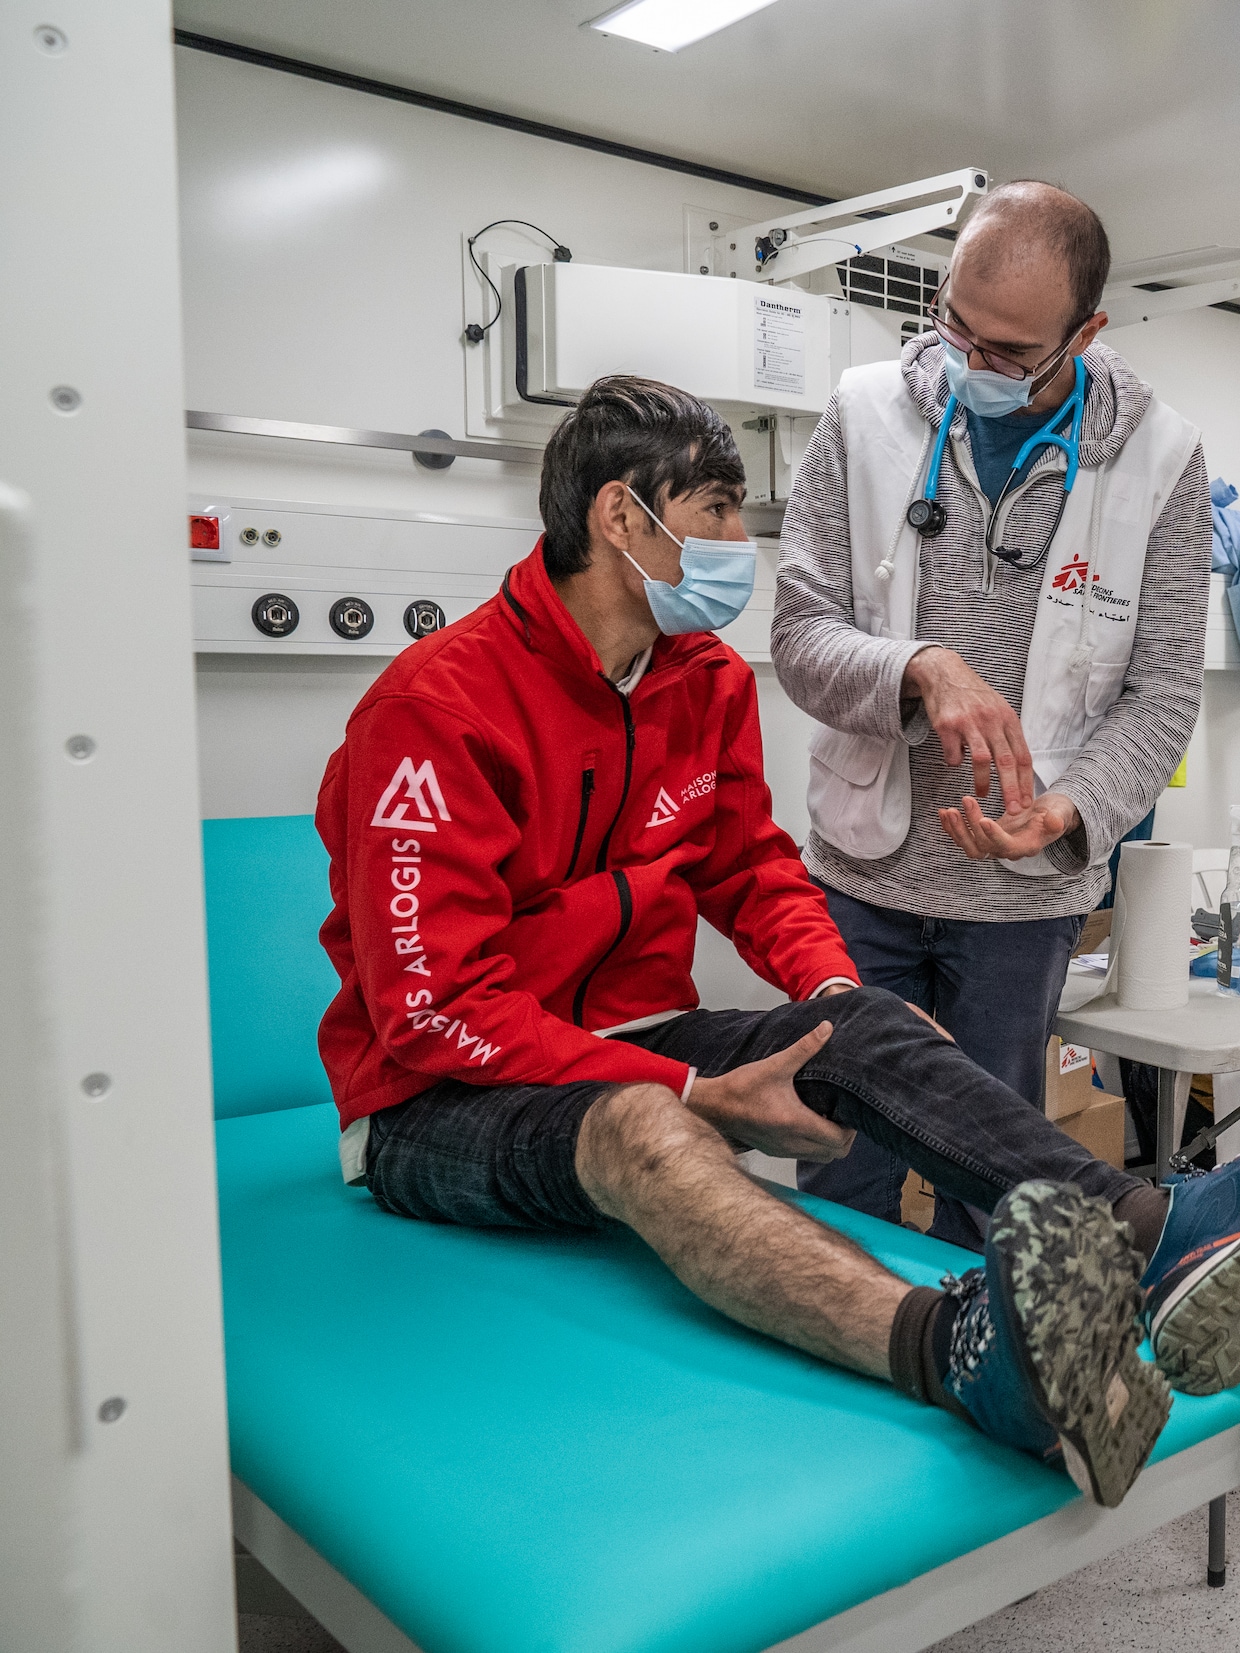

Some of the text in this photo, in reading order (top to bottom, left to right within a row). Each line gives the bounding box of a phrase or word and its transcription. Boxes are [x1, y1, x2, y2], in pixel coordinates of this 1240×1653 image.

[760, 300, 801, 314] Dantherm
[1079, 581, 1114, 597] MDECINS
[389, 837, 433, 978] ARLOGIS
